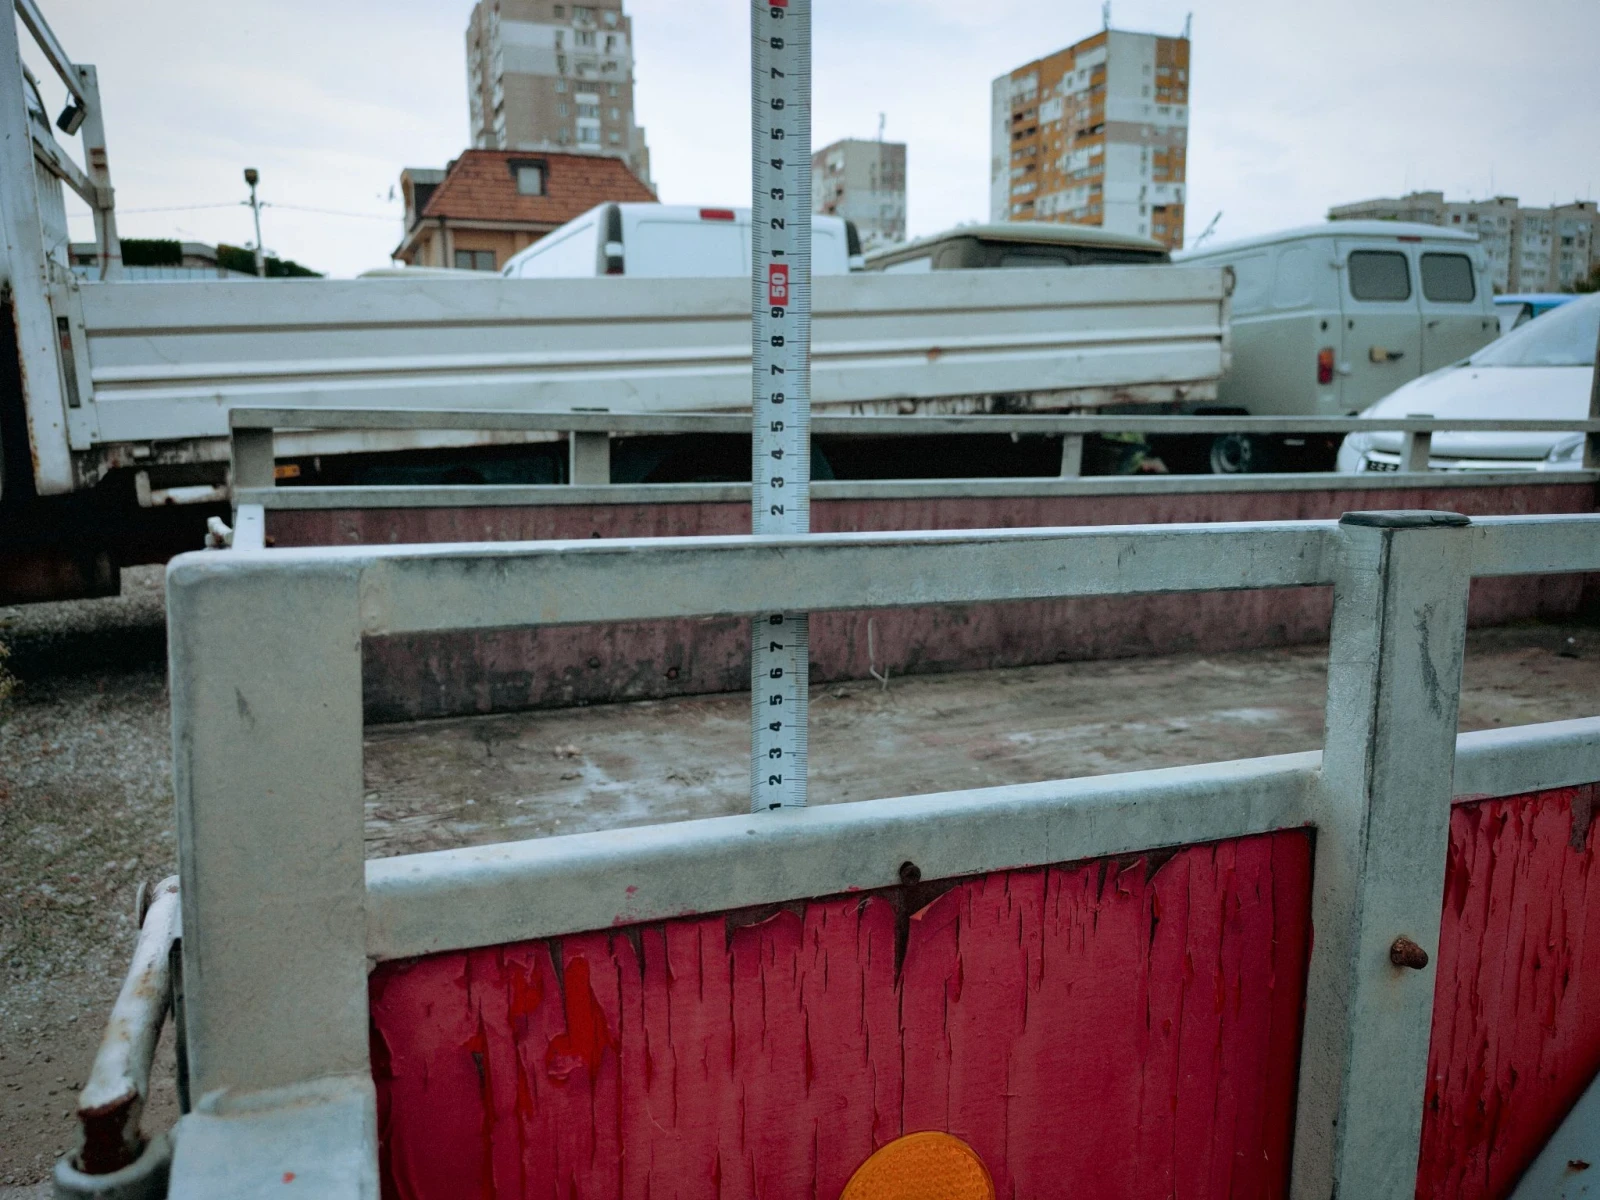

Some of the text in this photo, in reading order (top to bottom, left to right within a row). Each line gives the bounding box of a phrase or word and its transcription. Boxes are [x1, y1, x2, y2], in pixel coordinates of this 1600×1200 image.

[770, 7, 784, 19] 9
[770, 37, 784, 50] 8
[771, 67, 785, 79] 7
[771, 98, 784, 110] 6
[771, 128, 785, 140] 5
[771, 158, 784, 170] 4
[771, 188, 784, 200] 3
[771, 218, 785, 230] 2
[771, 272, 786, 298] 50
[771, 306, 784, 318] 9
[771, 335, 784, 347] 8
[771, 364, 784, 375] 7
[771, 392, 784, 404] 6
[771, 420, 784, 432] 5
[771, 448, 784, 460] 4
[771, 476, 784, 488] 3
[771, 504, 784, 515] 2
[770, 641, 783, 652] 7
[770, 667, 783, 679] 6
[770, 694, 783, 706] 5
[769, 721, 782, 732] 4
[769, 747, 782, 759] 3
[769, 774, 782, 786] 2
[769, 802, 782, 811] 1
